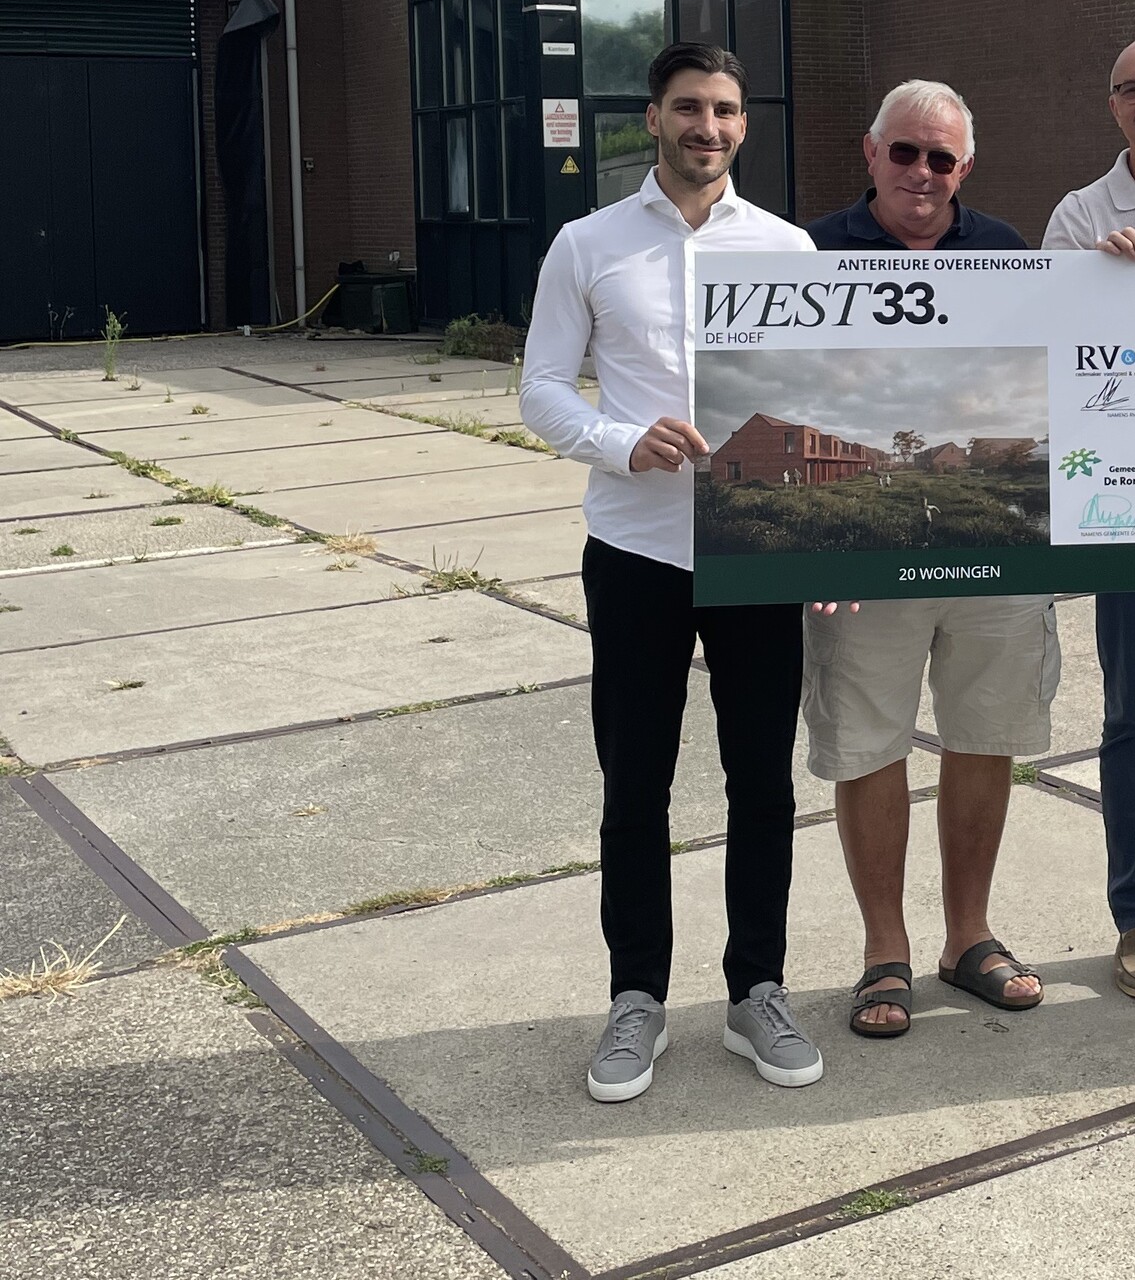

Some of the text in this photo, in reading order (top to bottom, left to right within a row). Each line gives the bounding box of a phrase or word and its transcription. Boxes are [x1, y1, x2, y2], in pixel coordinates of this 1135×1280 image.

[837, 258, 1053, 271] ANTERIEURE OVEREENKOMST
[705, 331, 765, 344] DE HOEF
[1104, 476, 1118, 486] De
[898, 565, 1001, 581] 20 WONINGEN
